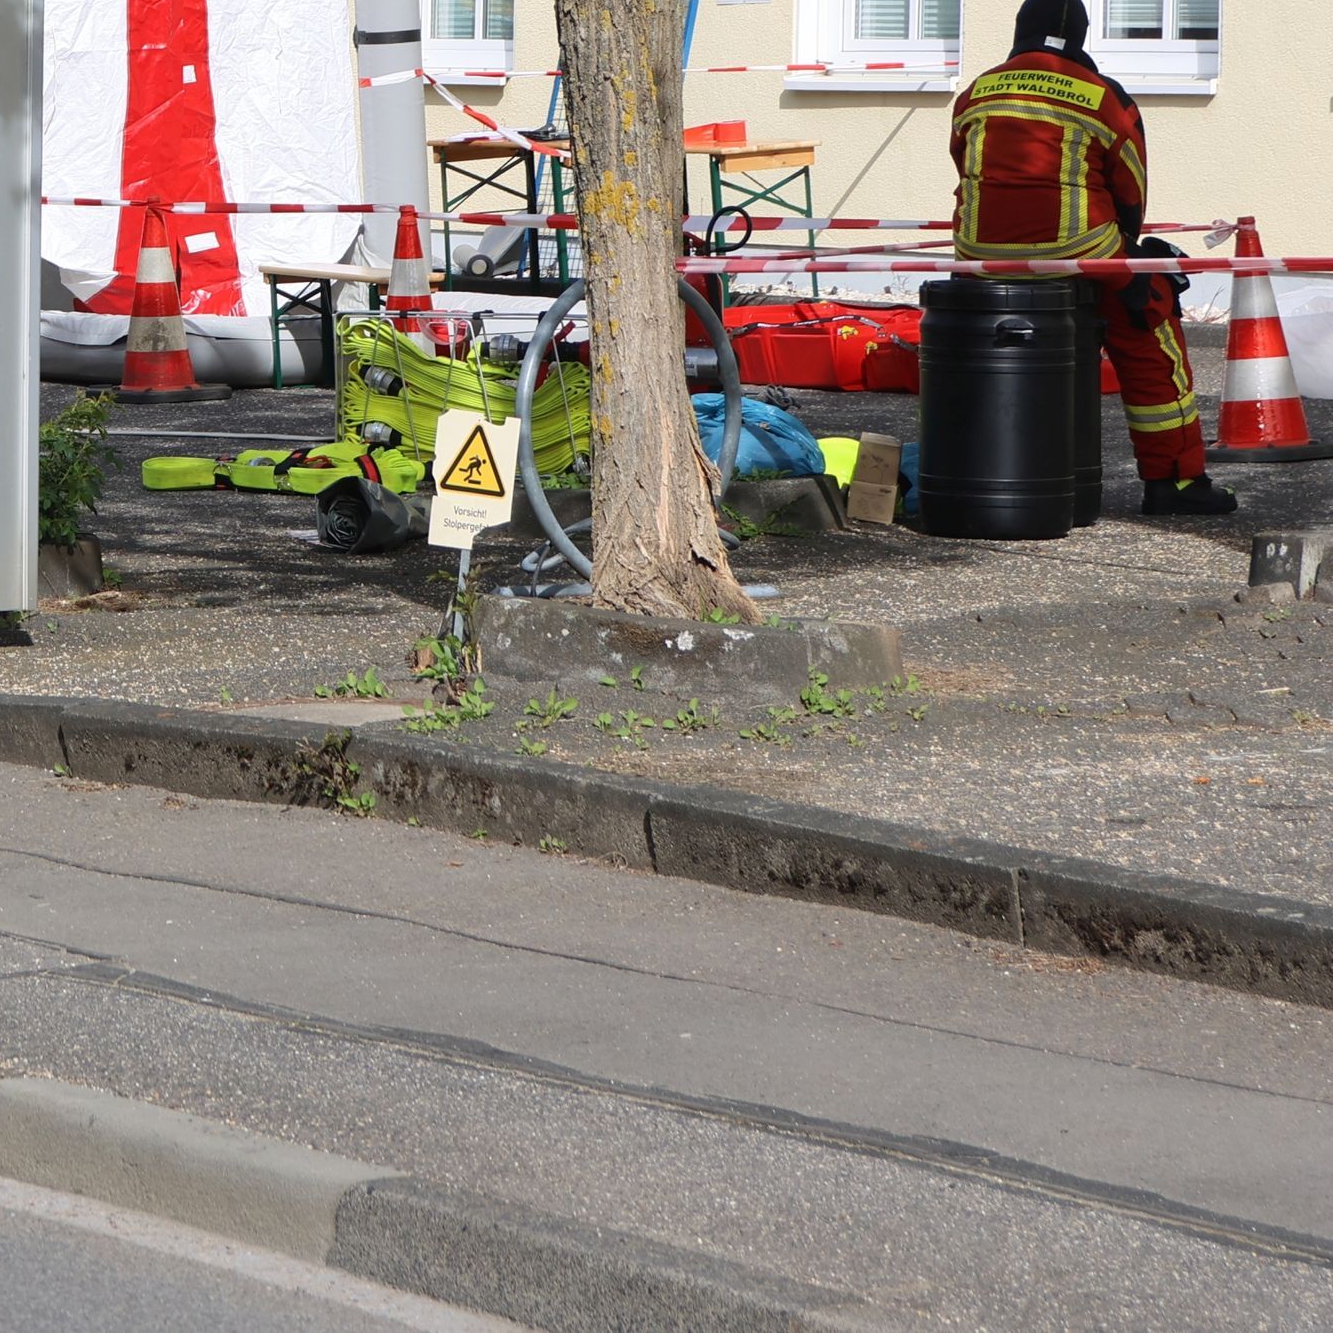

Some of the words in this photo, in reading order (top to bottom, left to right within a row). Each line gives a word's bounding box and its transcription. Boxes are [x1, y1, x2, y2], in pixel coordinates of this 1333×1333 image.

[998, 73, 1073, 88] FEUERWEHR
[974, 83, 1013, 96] STADT
[1017, 82, 1093, 106] WALDBRÖL
[453, 505, 487, 519] Vorsicht!
[443, 517, 490, 533] Stolpergef
